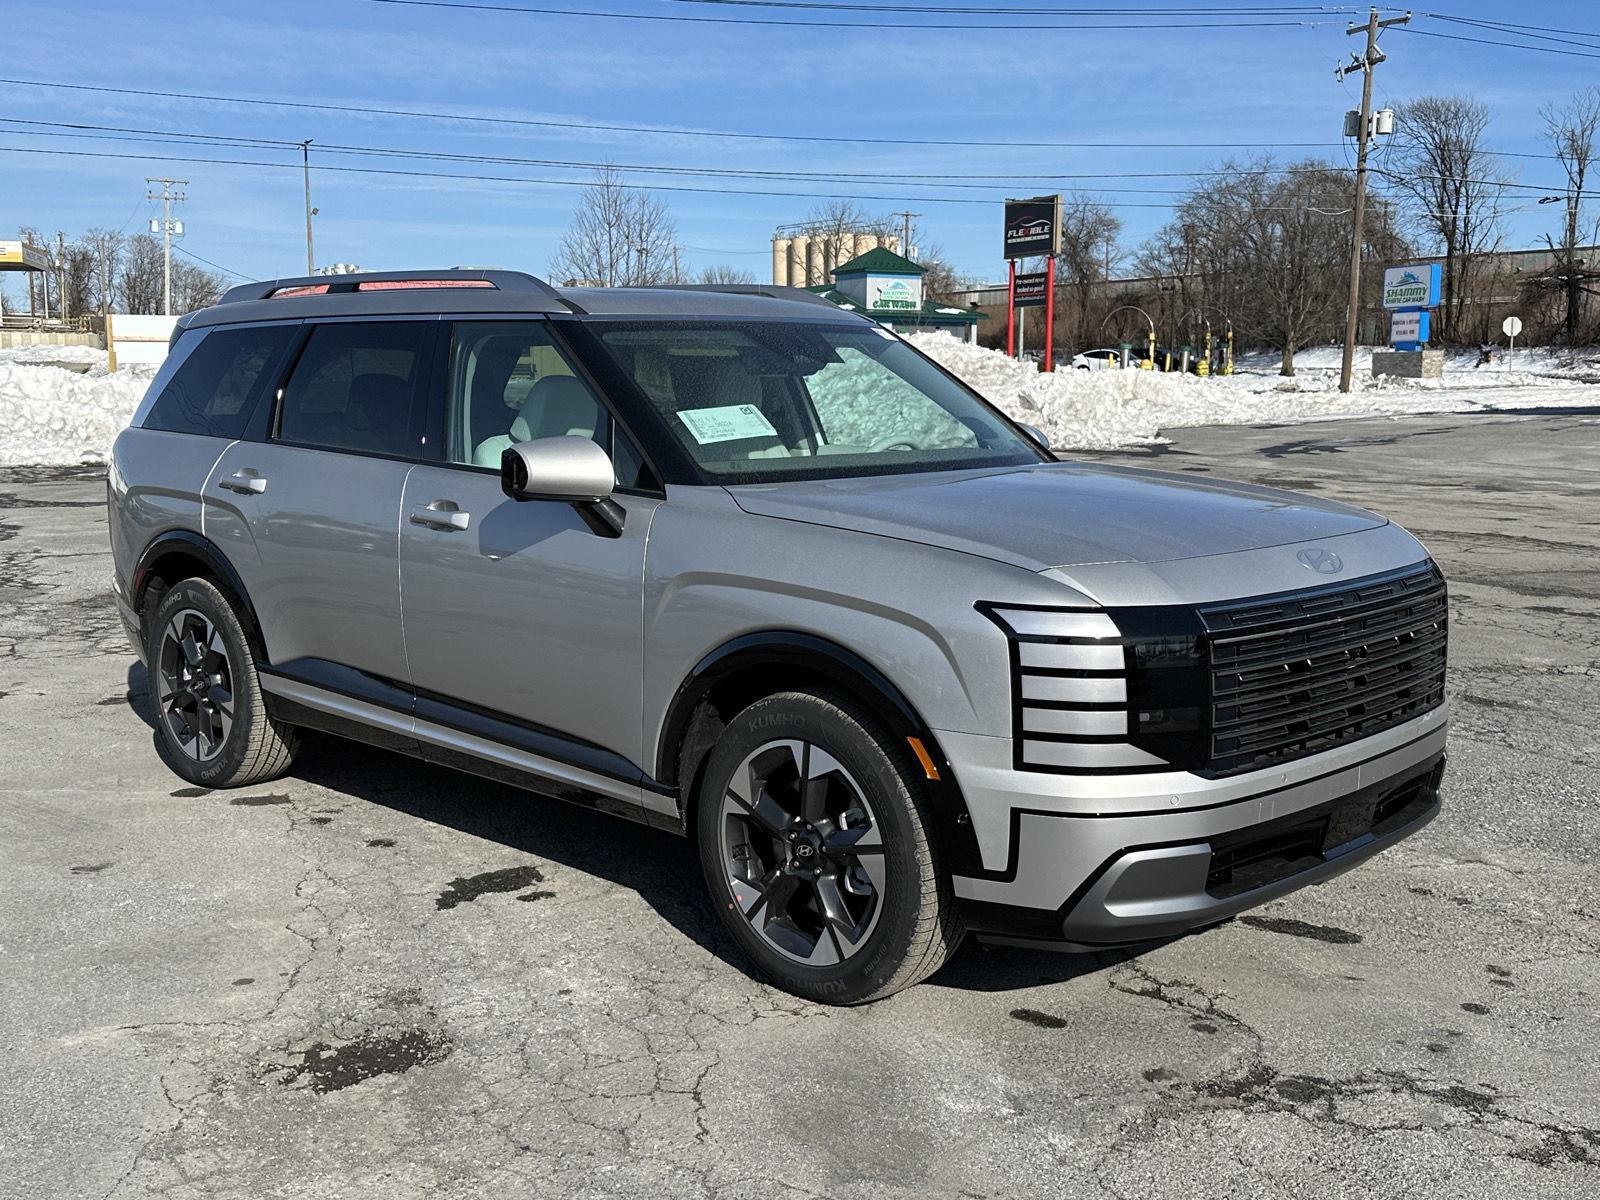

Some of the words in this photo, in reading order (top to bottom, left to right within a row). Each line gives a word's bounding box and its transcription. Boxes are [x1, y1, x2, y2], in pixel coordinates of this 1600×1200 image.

[1008, 225, 1051, 238] FLEXIBLE
[1387, 287, 1428, 297] SHAMMY
[872, 300, 891, 309] CAR
[891, 300, 917, 309] WASH
[749, 713, 807, 733] KUMHO
[784, 976, 848, 994] KUMHO
